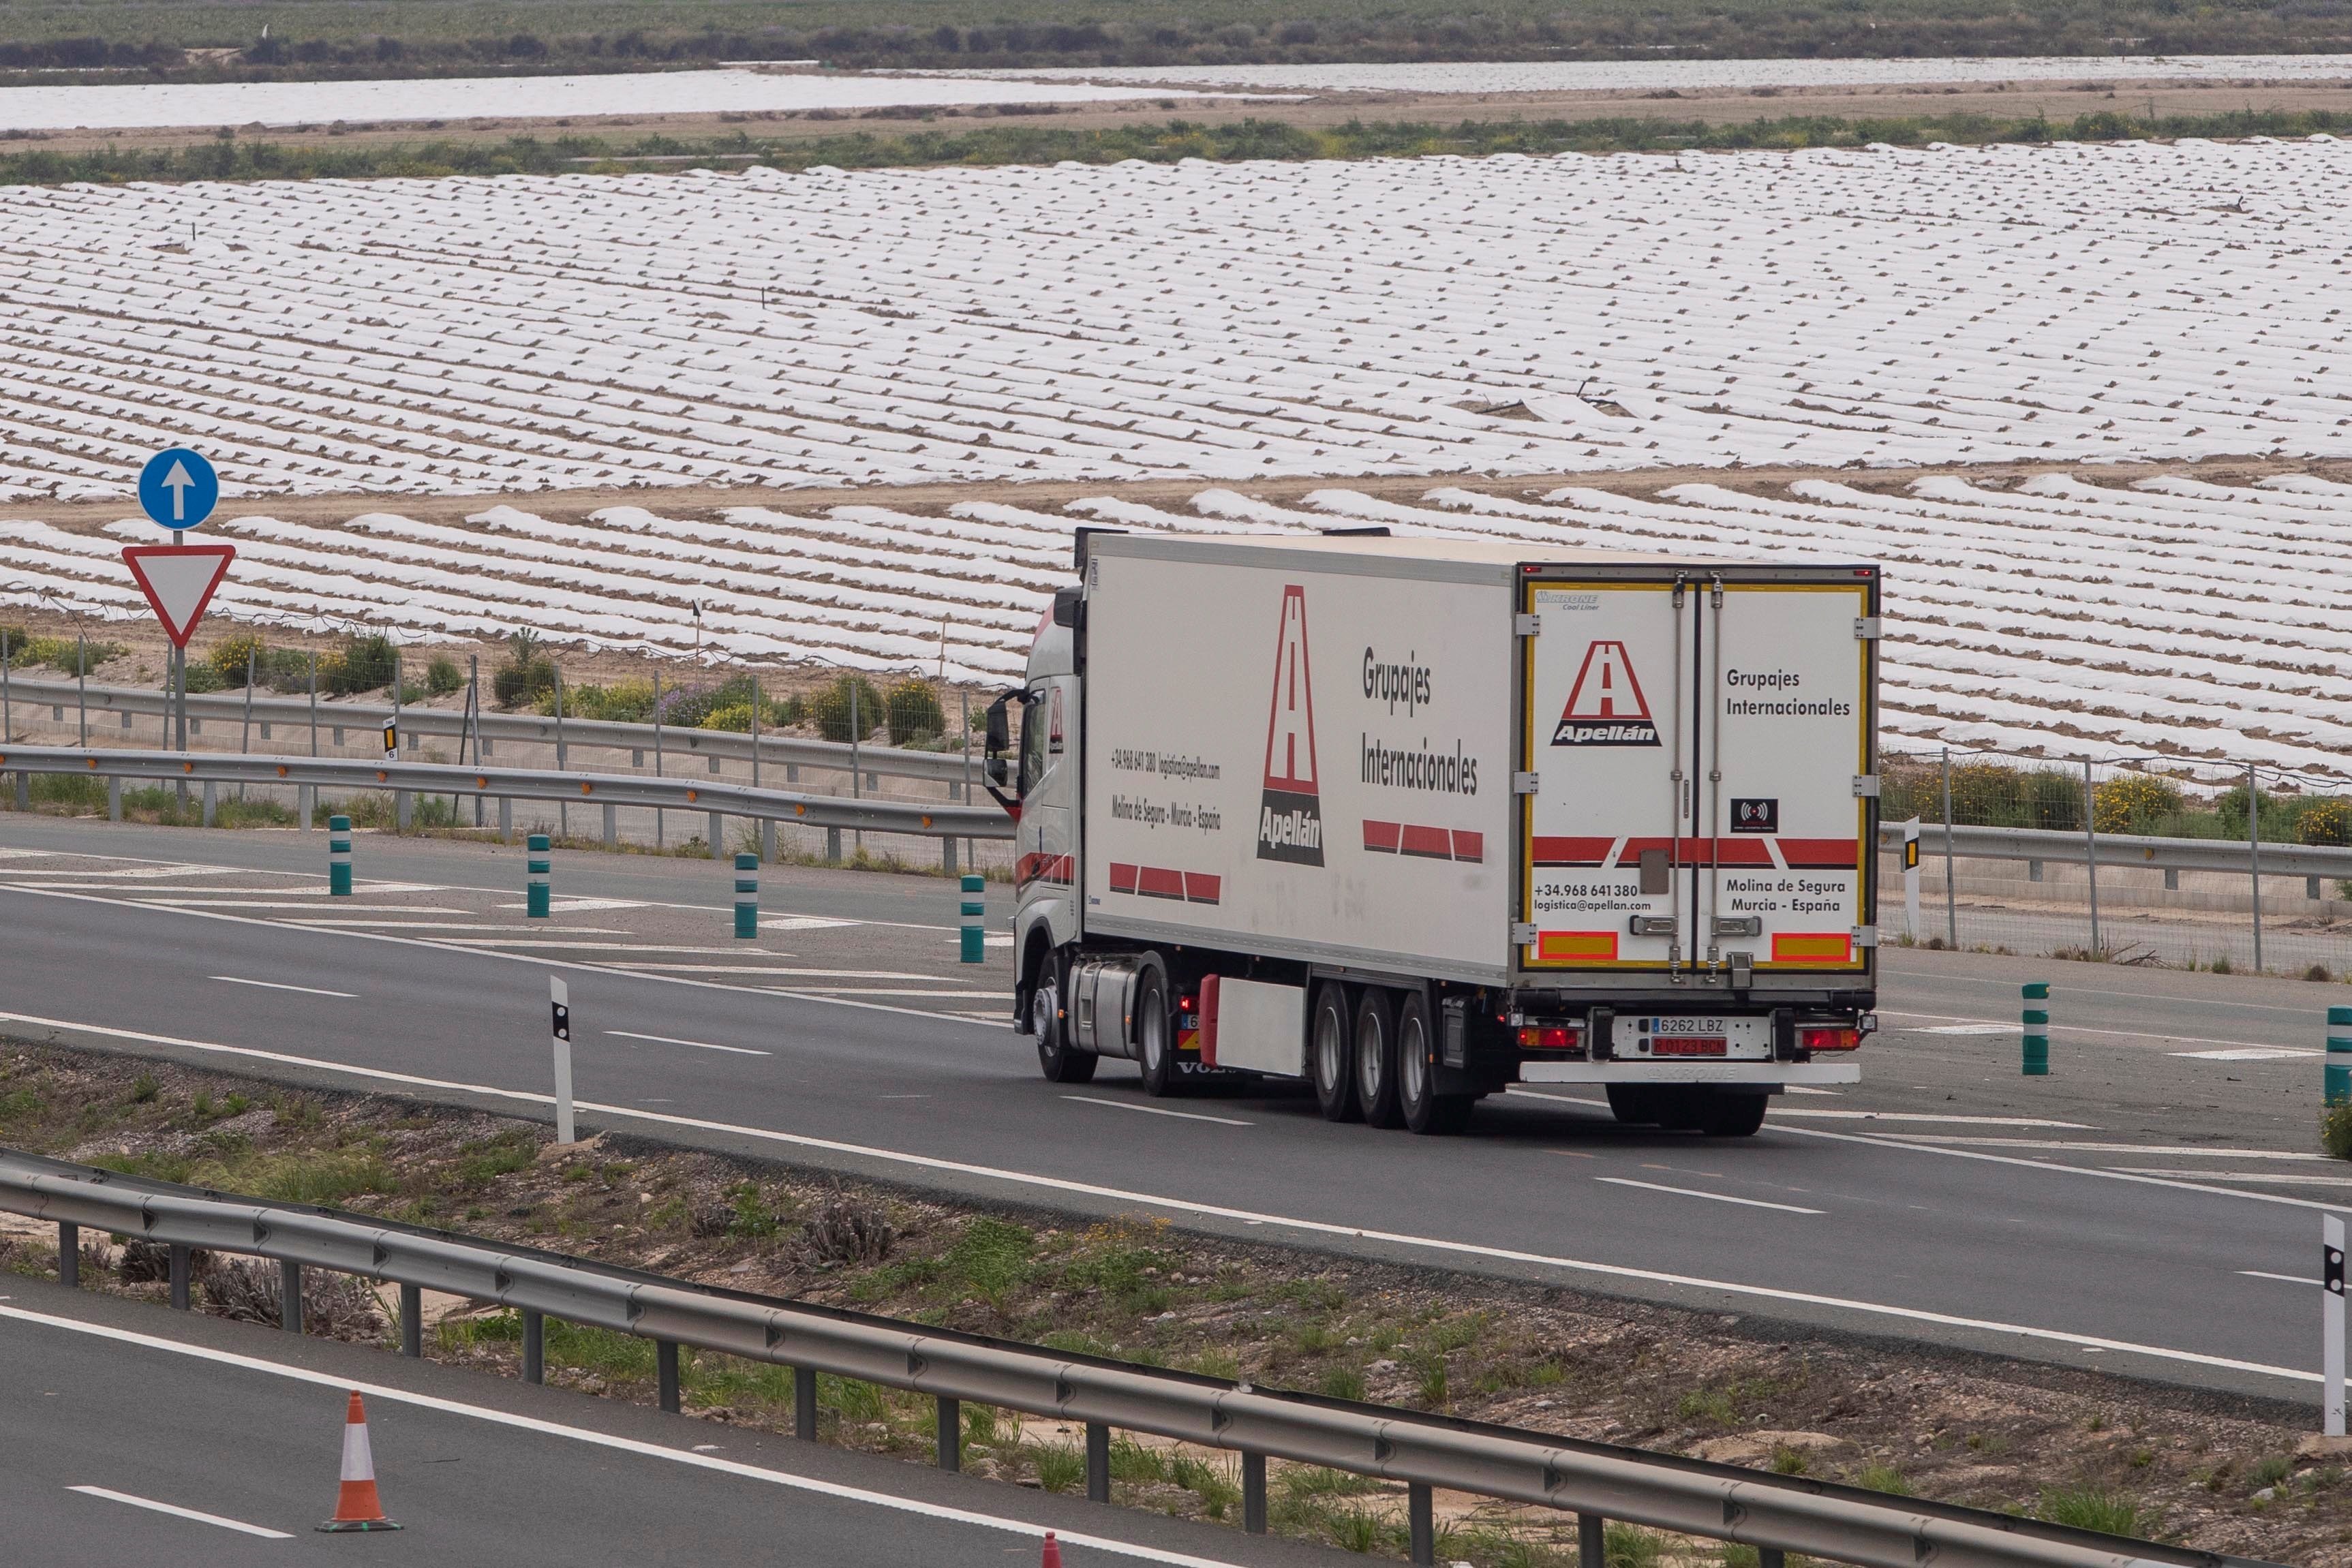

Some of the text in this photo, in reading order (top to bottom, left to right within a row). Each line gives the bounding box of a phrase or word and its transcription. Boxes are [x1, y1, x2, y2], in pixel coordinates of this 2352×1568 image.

[1362, 646, 1431, 718] Grupajes
[1726, 668, 1800, 691] Grupajes
[1726, 697, 1850, 716] Internacionales
[1555, 725, 1655, 743] Apellán
[1112, 748, 1221, 783] +34.968 641 380 logistica@apellan.com
[1362, 732, 1477, 796] Internacionales
[1112, 793, 1133, 820] Molina
[1134, 795, 1142, 821] de
[1144, 797, 1165, 829] Segura
[1171, 801, 1192, 827] Murcia
[1198, 804, 1221, 835] España
[1259, 806, 1320, 849] Apellán
[1535, 885, 1638, 896] +34.968 641 380
[1726, 878, 1846, 895] Molina de Segura
[1534, 900, 1651, 912] logistica@apellan.com
[1731, 898, 1777, 911] Murcia
[1792, 898, 1840, 914] España
[1661, 1019, 1724, 1032] 6262 LBZ
